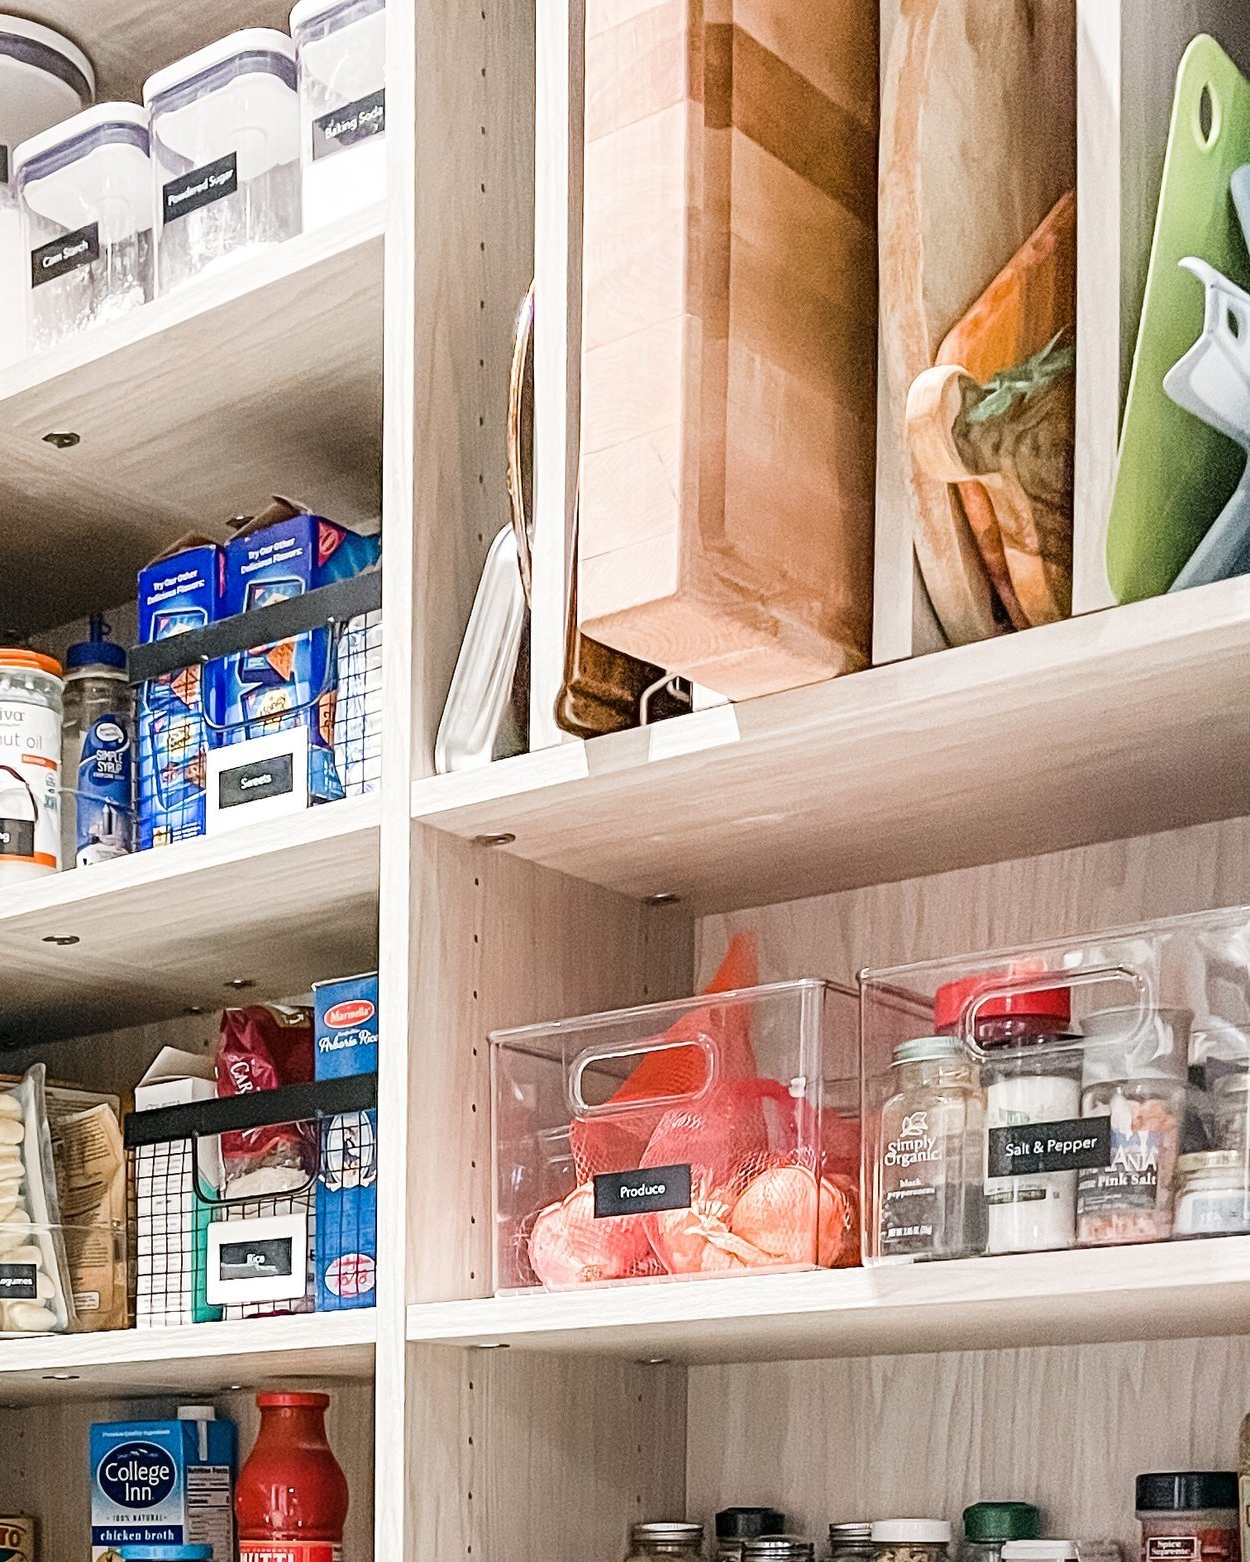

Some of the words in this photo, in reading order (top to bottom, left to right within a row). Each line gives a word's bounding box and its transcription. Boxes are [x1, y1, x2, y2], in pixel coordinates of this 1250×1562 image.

[26, 735, 43, 751] oil
[97, 761, 123, 774] SYRUP
[887, 1135, 937, 1155] Simply
[1005, 1142, 1030, 1157] Salt
[1033, 1141, 1044, 1154] &
[1047, 1136, 1098, 1154] Pepper
[884, 1149, 940, 1168] Organic
[1097, 1174, 1128, 1188] Pink
[1130, 1172, 1157, 1186] Salt
[619, 1182, 666, 1200] Produce
[105, 1460, 170, 1487] College
[125, 1482, 152, 1502] Inn
[132, 1514, 164, 1523] NATURAL
[100, 1529, 143, 1541] chicken
[144, 1529, 175, 1541] broth
